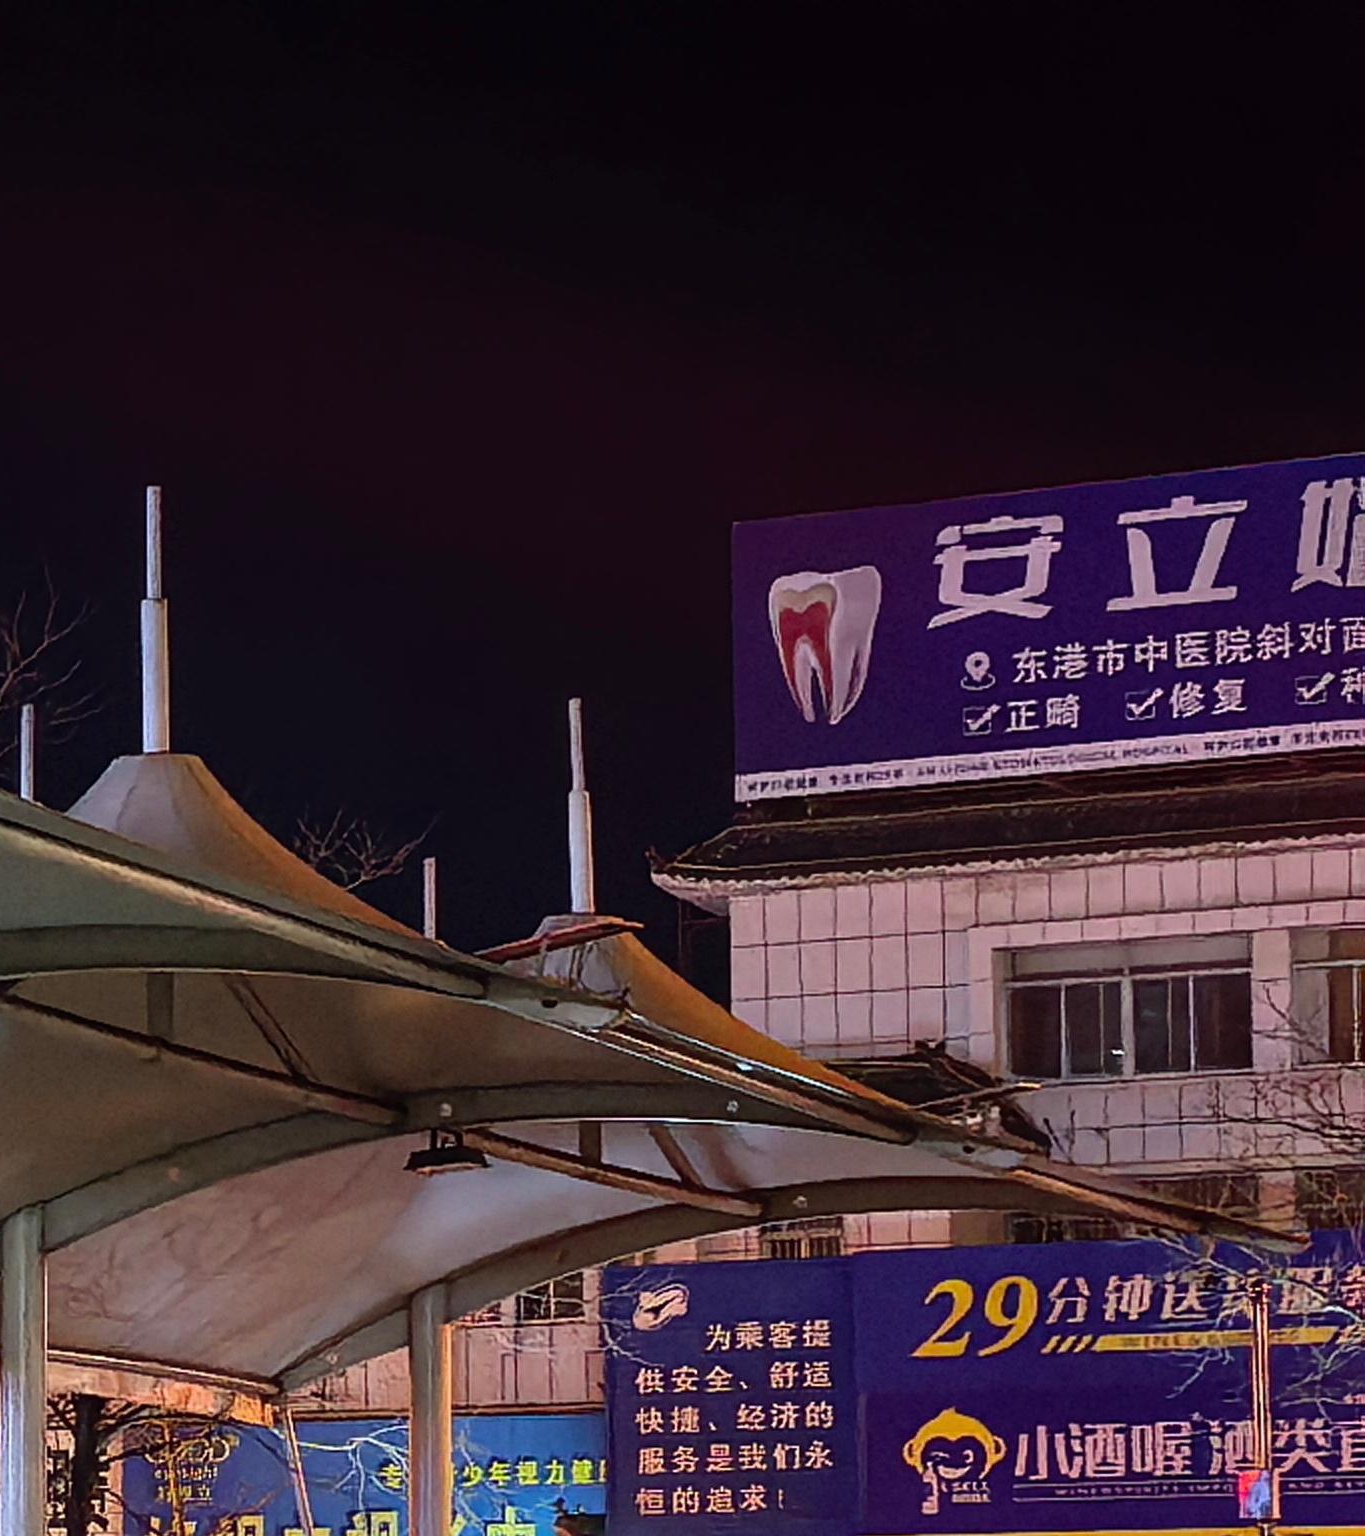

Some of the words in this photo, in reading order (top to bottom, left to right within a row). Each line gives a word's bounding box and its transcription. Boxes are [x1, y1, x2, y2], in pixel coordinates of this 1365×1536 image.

[1169, 678, 1248, 720] 修复
[705, 1318, 833, 1351] 为乘客提
[637, 1440, 834, 1475] 服务是我们永
